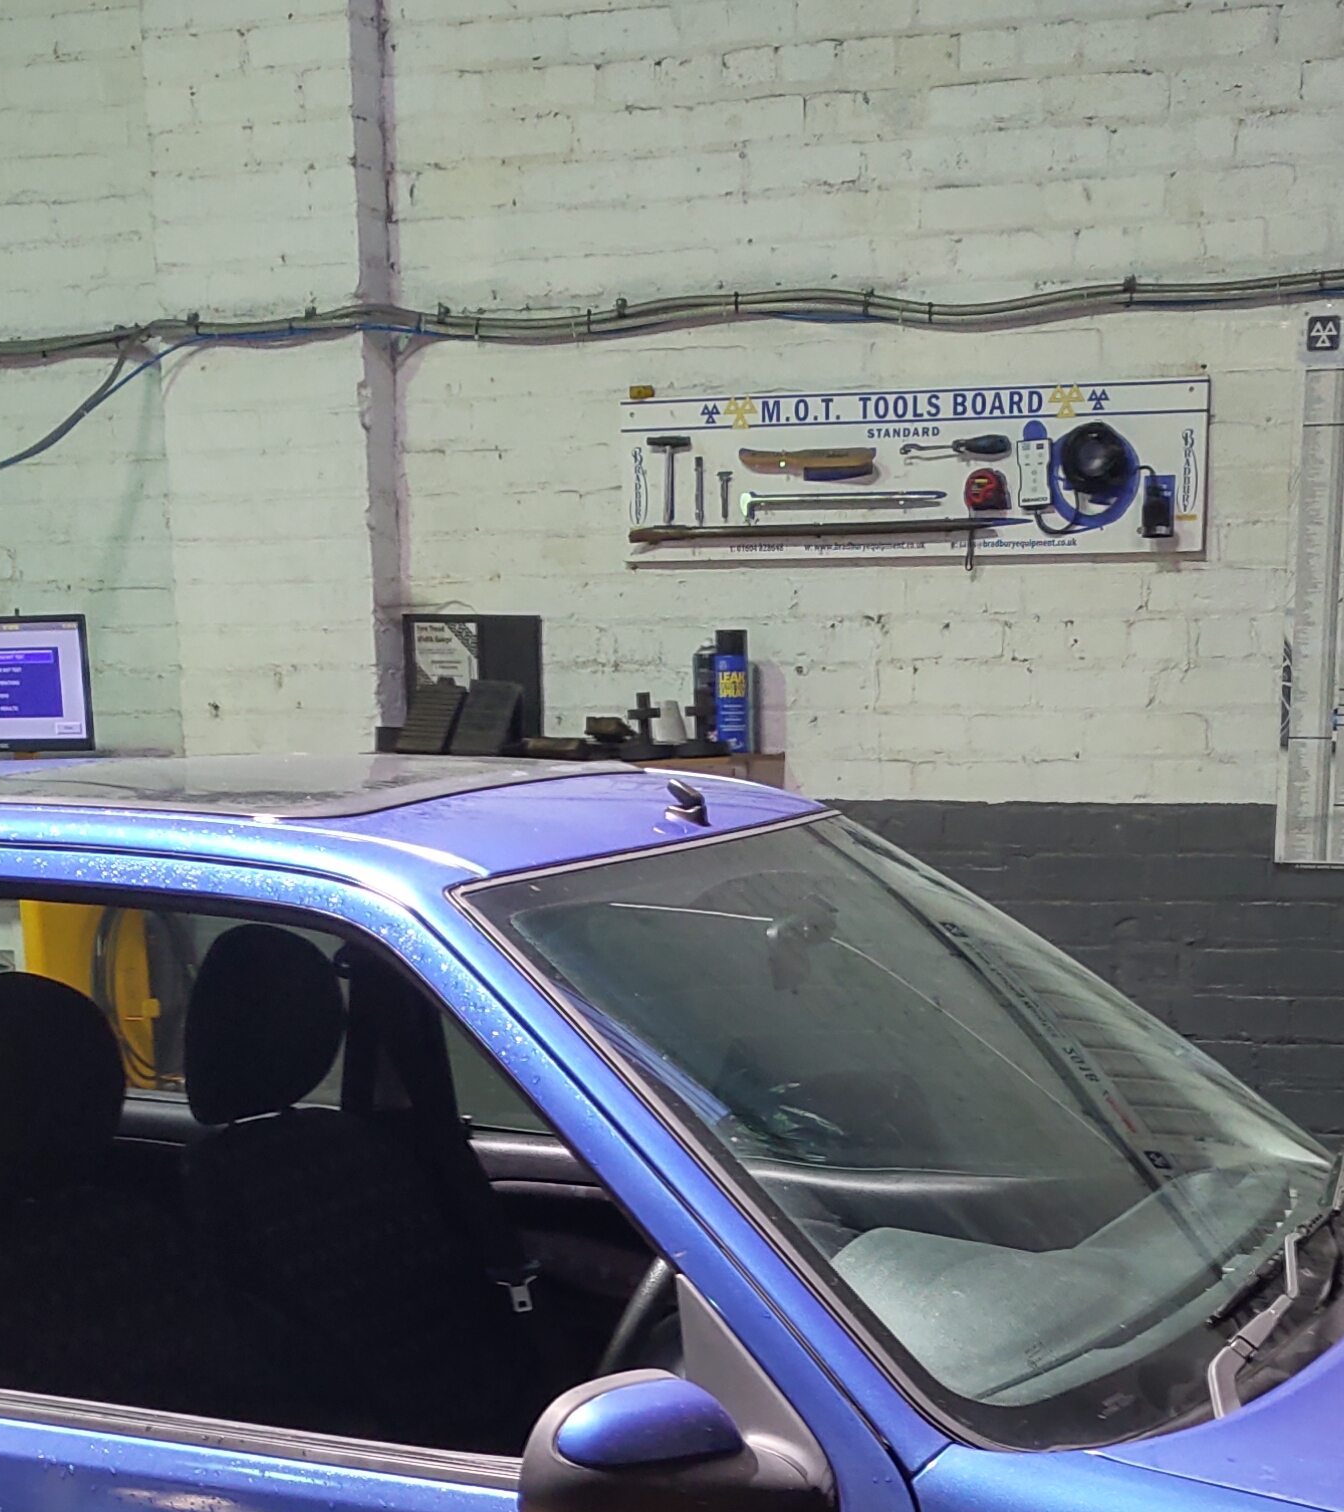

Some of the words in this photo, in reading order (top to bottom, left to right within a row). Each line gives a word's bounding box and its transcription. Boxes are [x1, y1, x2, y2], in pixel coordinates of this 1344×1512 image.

[761, 398, 841, 423] M.O.T.
[858, 394, 942, 419] TOOLS
[952, 390, 1043, 417] BOARD
[867, 426, 940, 439] STANDARD
